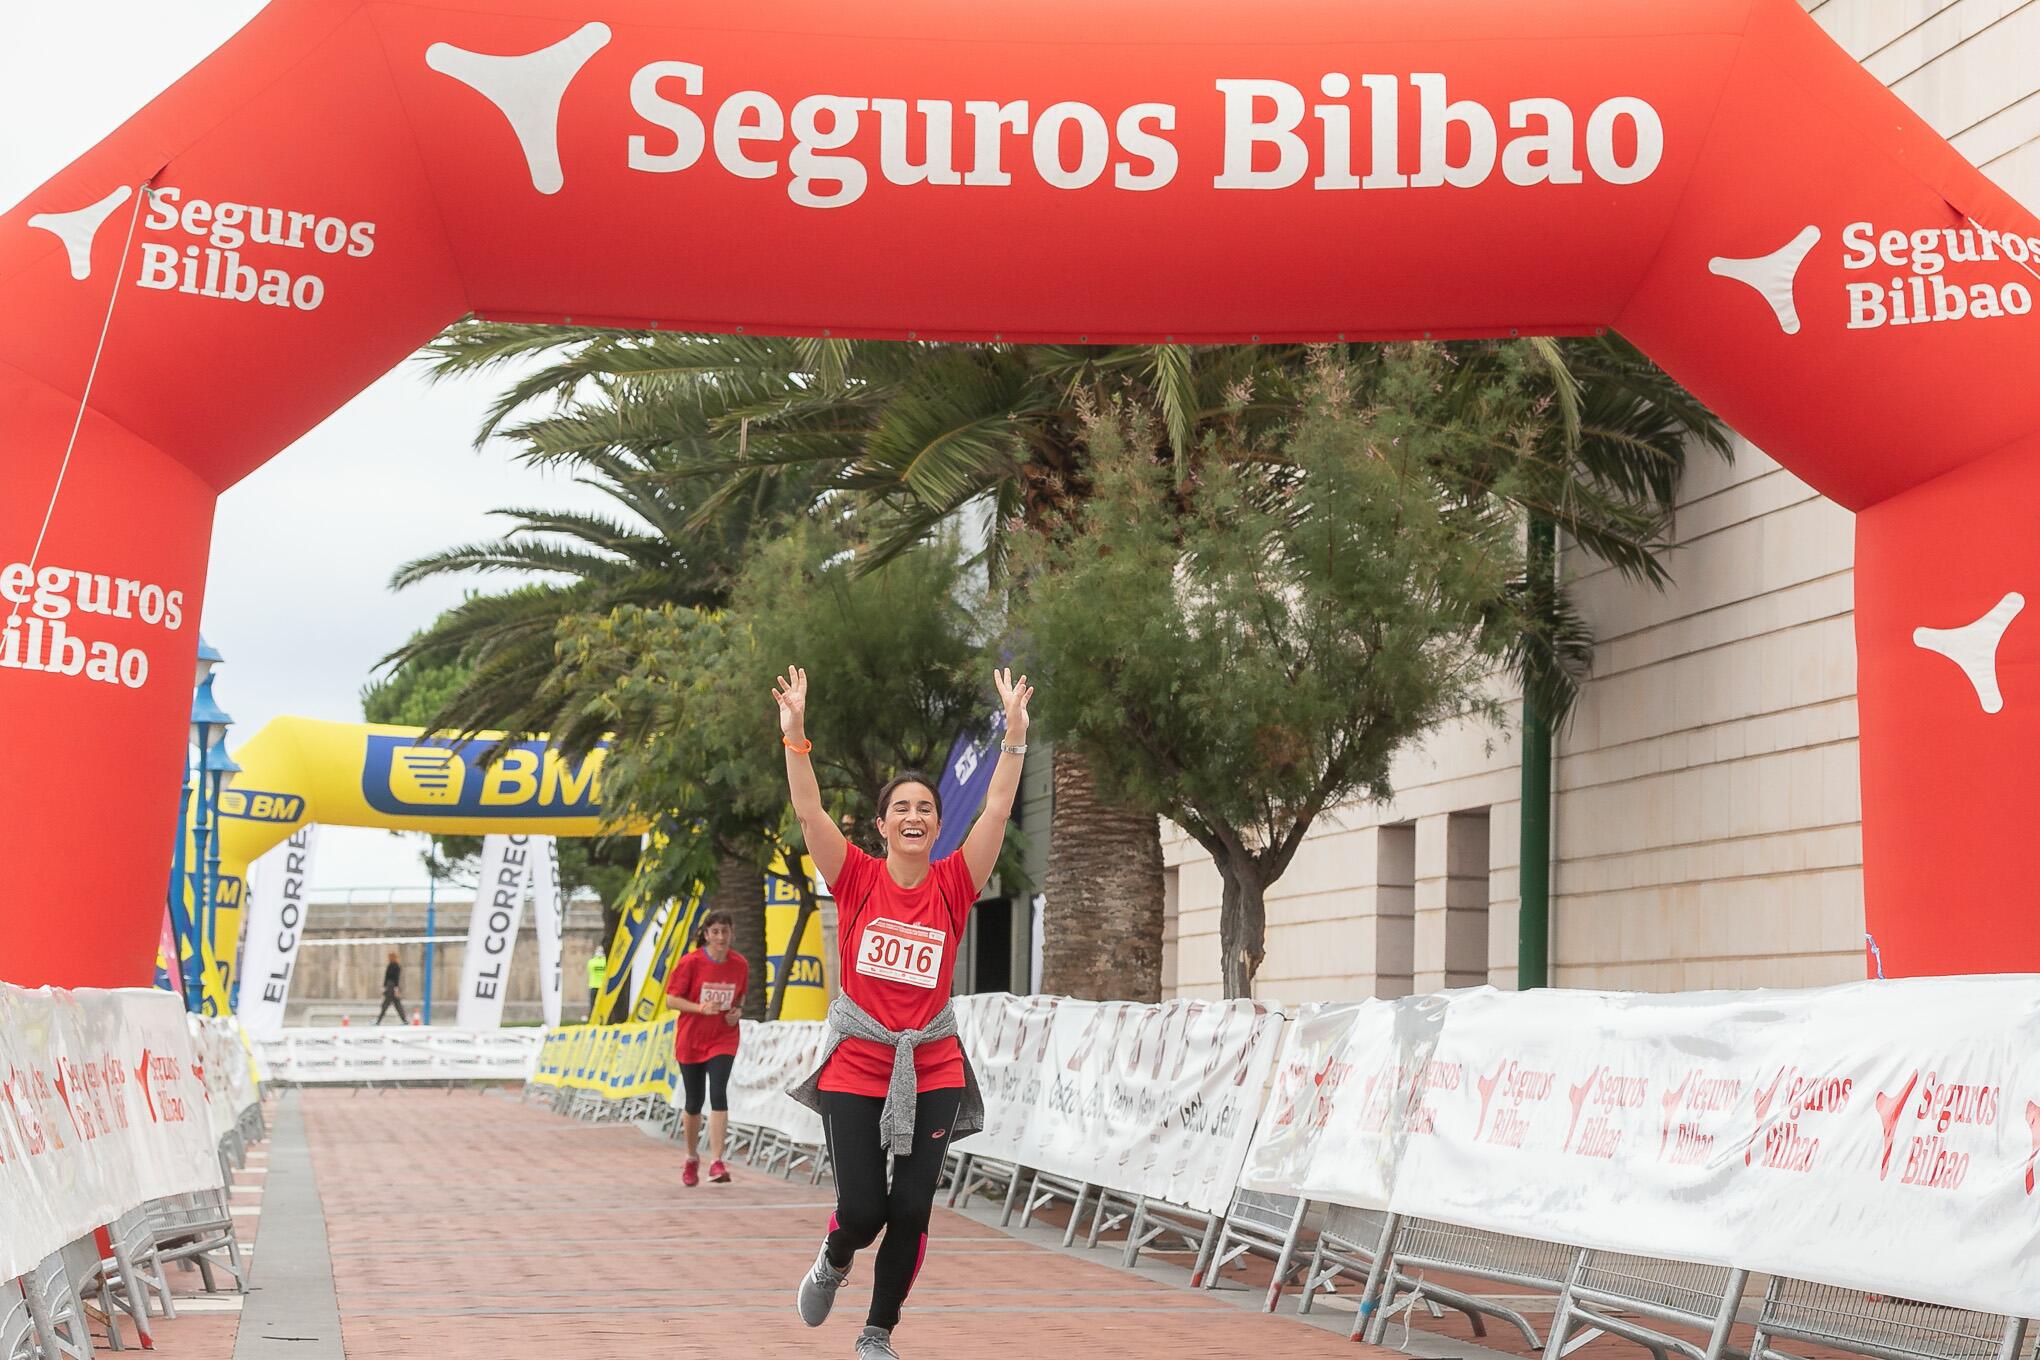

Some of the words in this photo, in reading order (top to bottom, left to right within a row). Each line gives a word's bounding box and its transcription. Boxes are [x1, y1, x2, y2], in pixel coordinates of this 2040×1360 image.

[628, 60, 1179, 209] Seguros
[1213, 72, 1664, 191] Bilbao
[144, 186, 376, 258] Seguros
[1842, 221, 2040, 275] Seguros
[136, 241, 325, 311] Bilbao
[1846, 276, 2033, 330] Bilbao
[0, 562, 183, 631] eguros
[0, 614, 148, 689] ilbao
[479, 748, 608, 807] BM
[249, 794, 300, 821] BM
[262, 962, 290, 1003] EL
[277, 829, 307, 954] CORRE
[475, 963, 501, 1000] EL
[867, 935, 934, 974] 3016
[1502, 1060, 1556, 1106] Seguros
[1593, 1065, 1649, 1115] Seguros
[1916, 1071, 2000, 1134] Seguros
[1761, 1122, 1821, 1173] Bilbao
[1900, 1135, 1970, 1190] Bilbao
